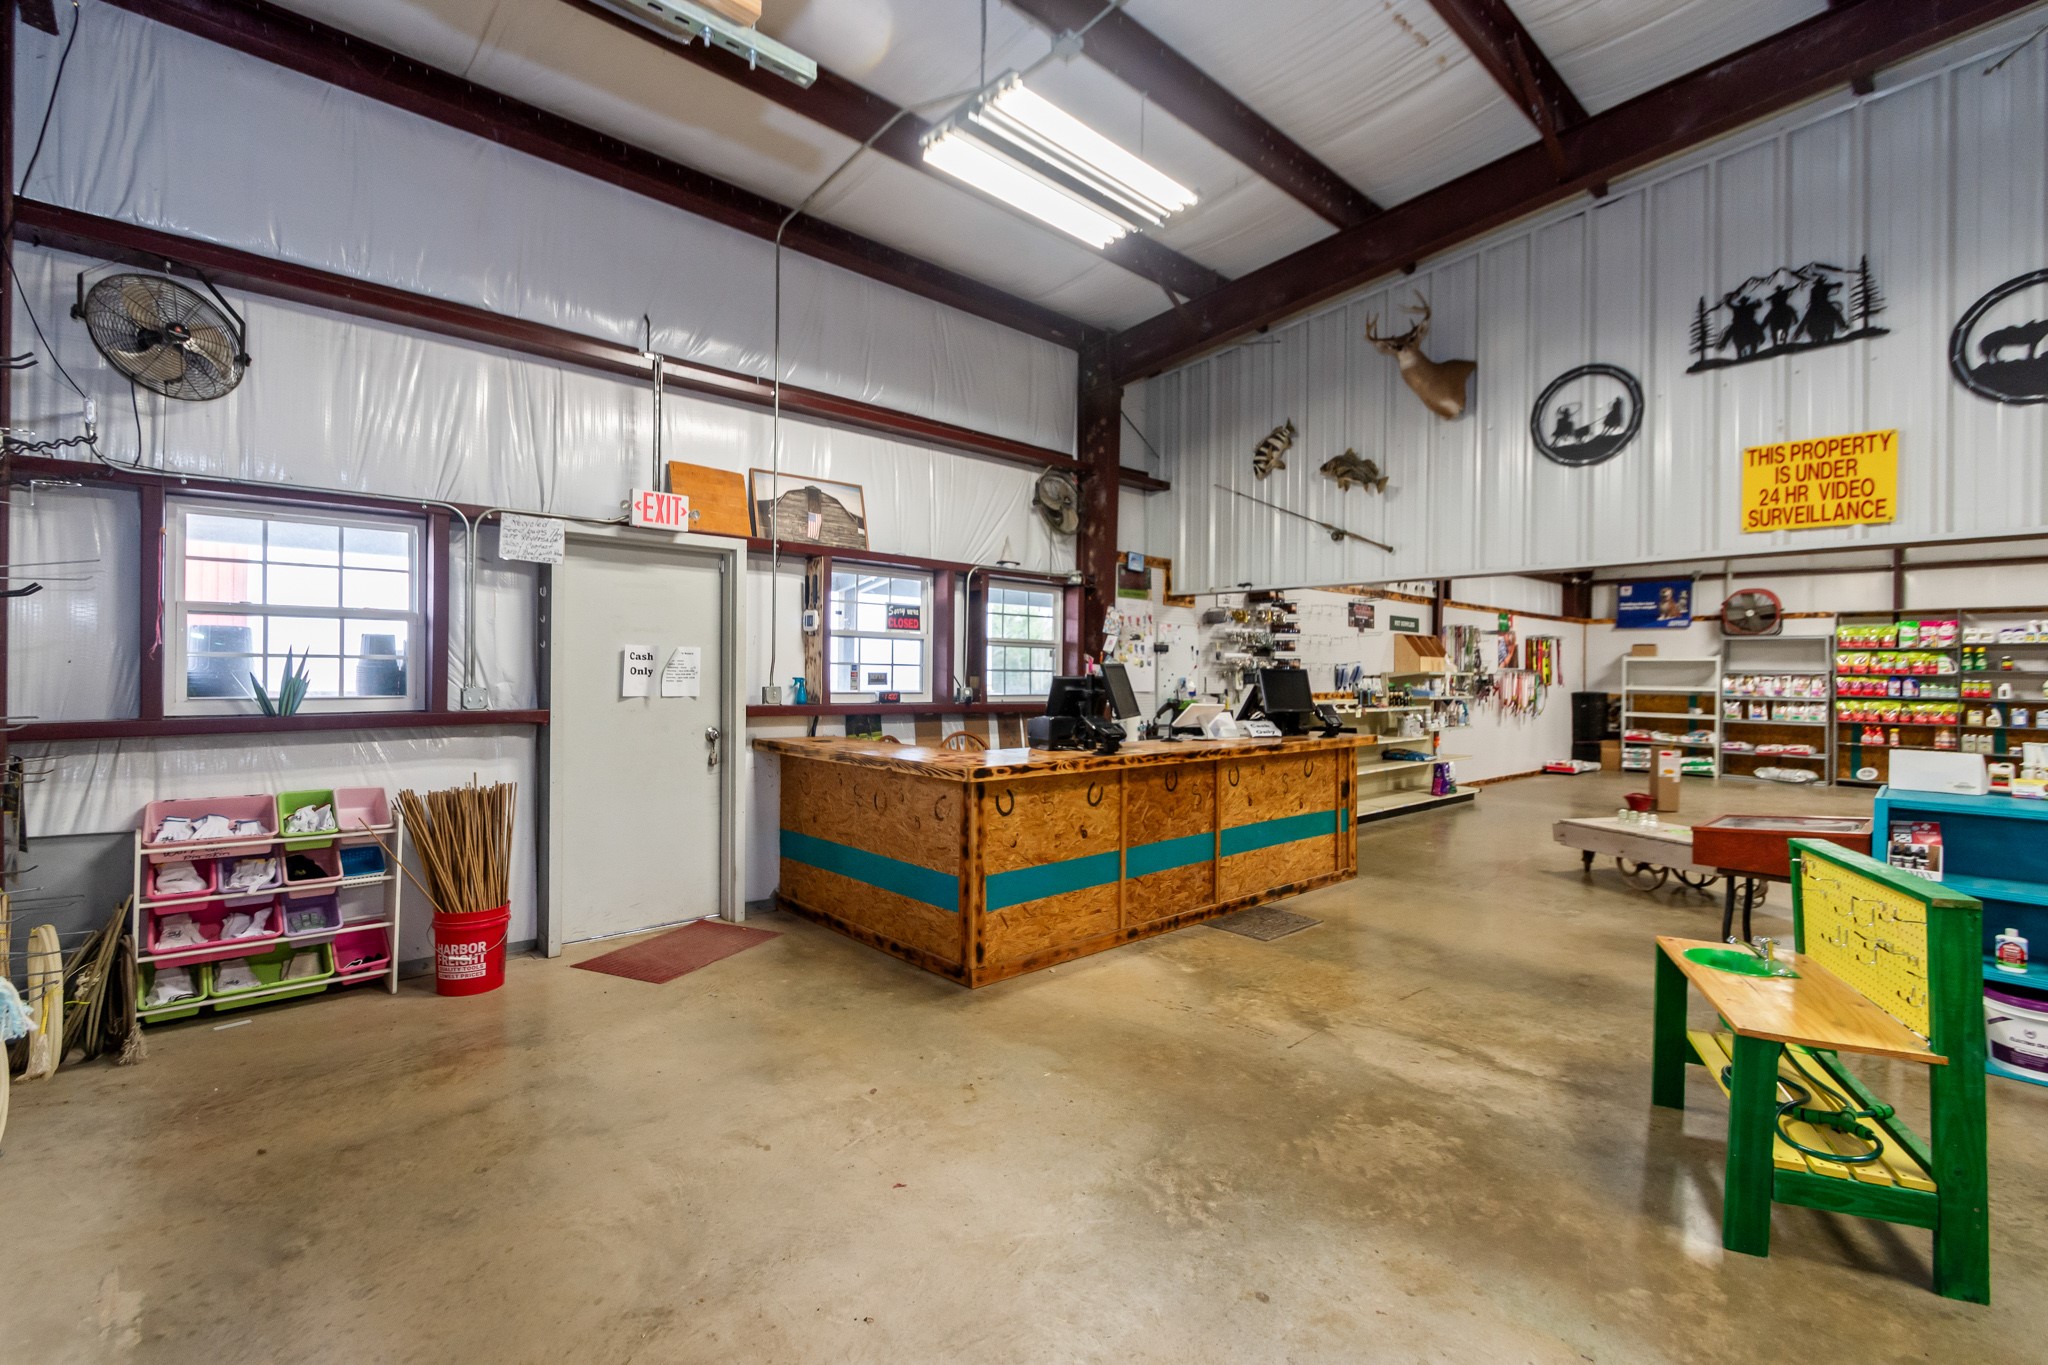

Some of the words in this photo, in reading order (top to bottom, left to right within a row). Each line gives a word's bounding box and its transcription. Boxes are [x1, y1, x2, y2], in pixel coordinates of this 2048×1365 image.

[1748, 446, 1785, 467] THIS
[1790, 433, 1892, 462] PROPERTY
[1775, 465, 1791, 484] IS
[1795, 458, 1858, 482] UNDER
[1759, 487, 1780, 506] 24
[1785, 484, 1808, 504] HR
[1818, 478, 1875, 501] VIDEO
[643, 491, 682, 526] EXIT
[1748, 498, 1888, 528] SURVEILLANCE
[888, 617, 919, 629] CLOSED
[629, 651, 654, 661] Cash
[630, 666, 654, 677] Only
[438, 941, 487, 955] HARBOR
[438, 952, 487, 966] FREIGHT
[460, 971, 484, 979] PRICES
